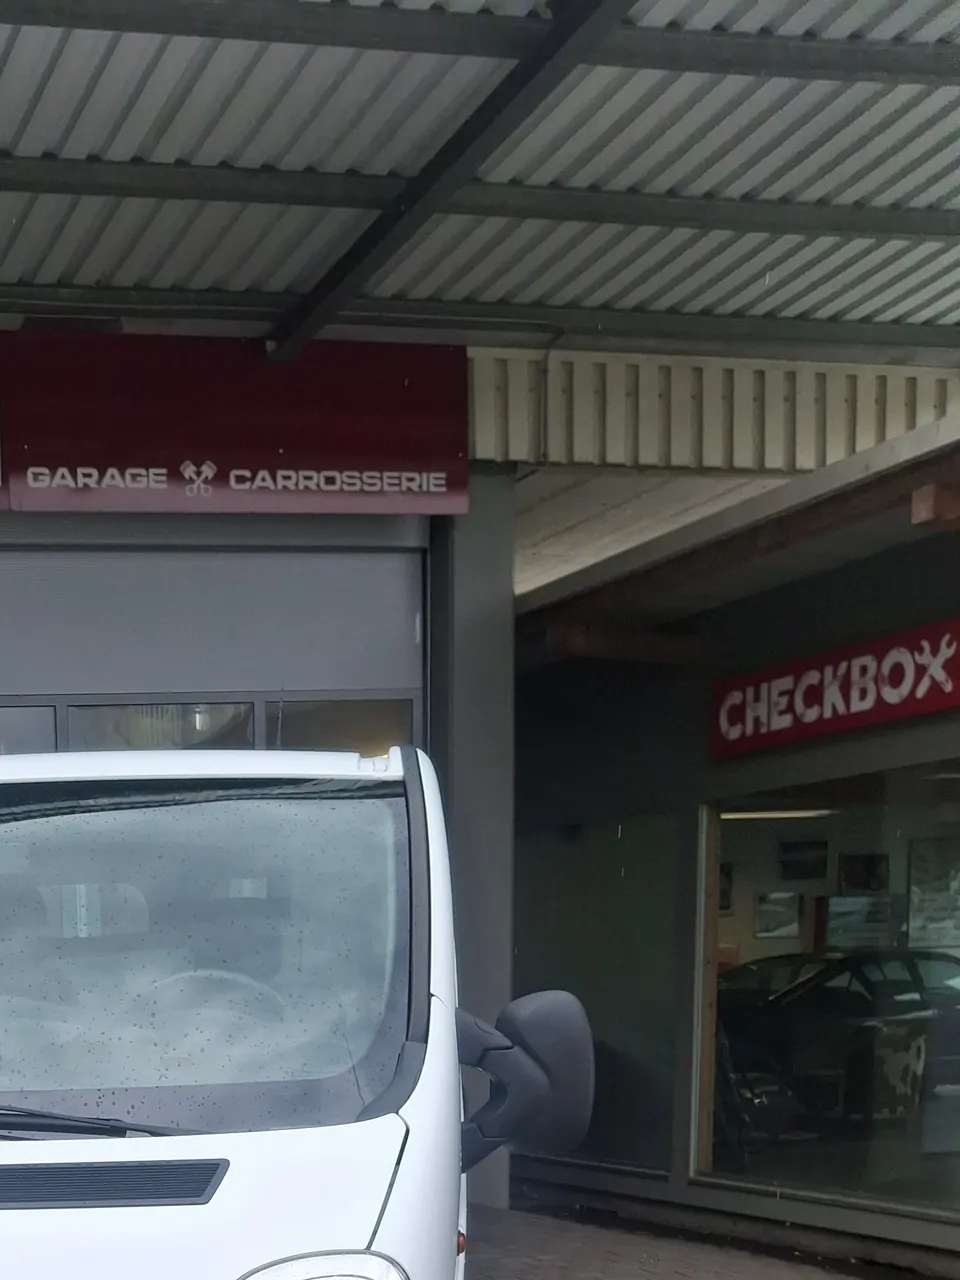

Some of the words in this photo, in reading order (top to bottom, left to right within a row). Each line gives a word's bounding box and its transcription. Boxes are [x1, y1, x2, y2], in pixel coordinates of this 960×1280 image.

[26, 466, 169, 490] GARAGE
[229, 468, 448, 493] CARROSSERIE
[718, 633, 957, 741] CHECKBOX
